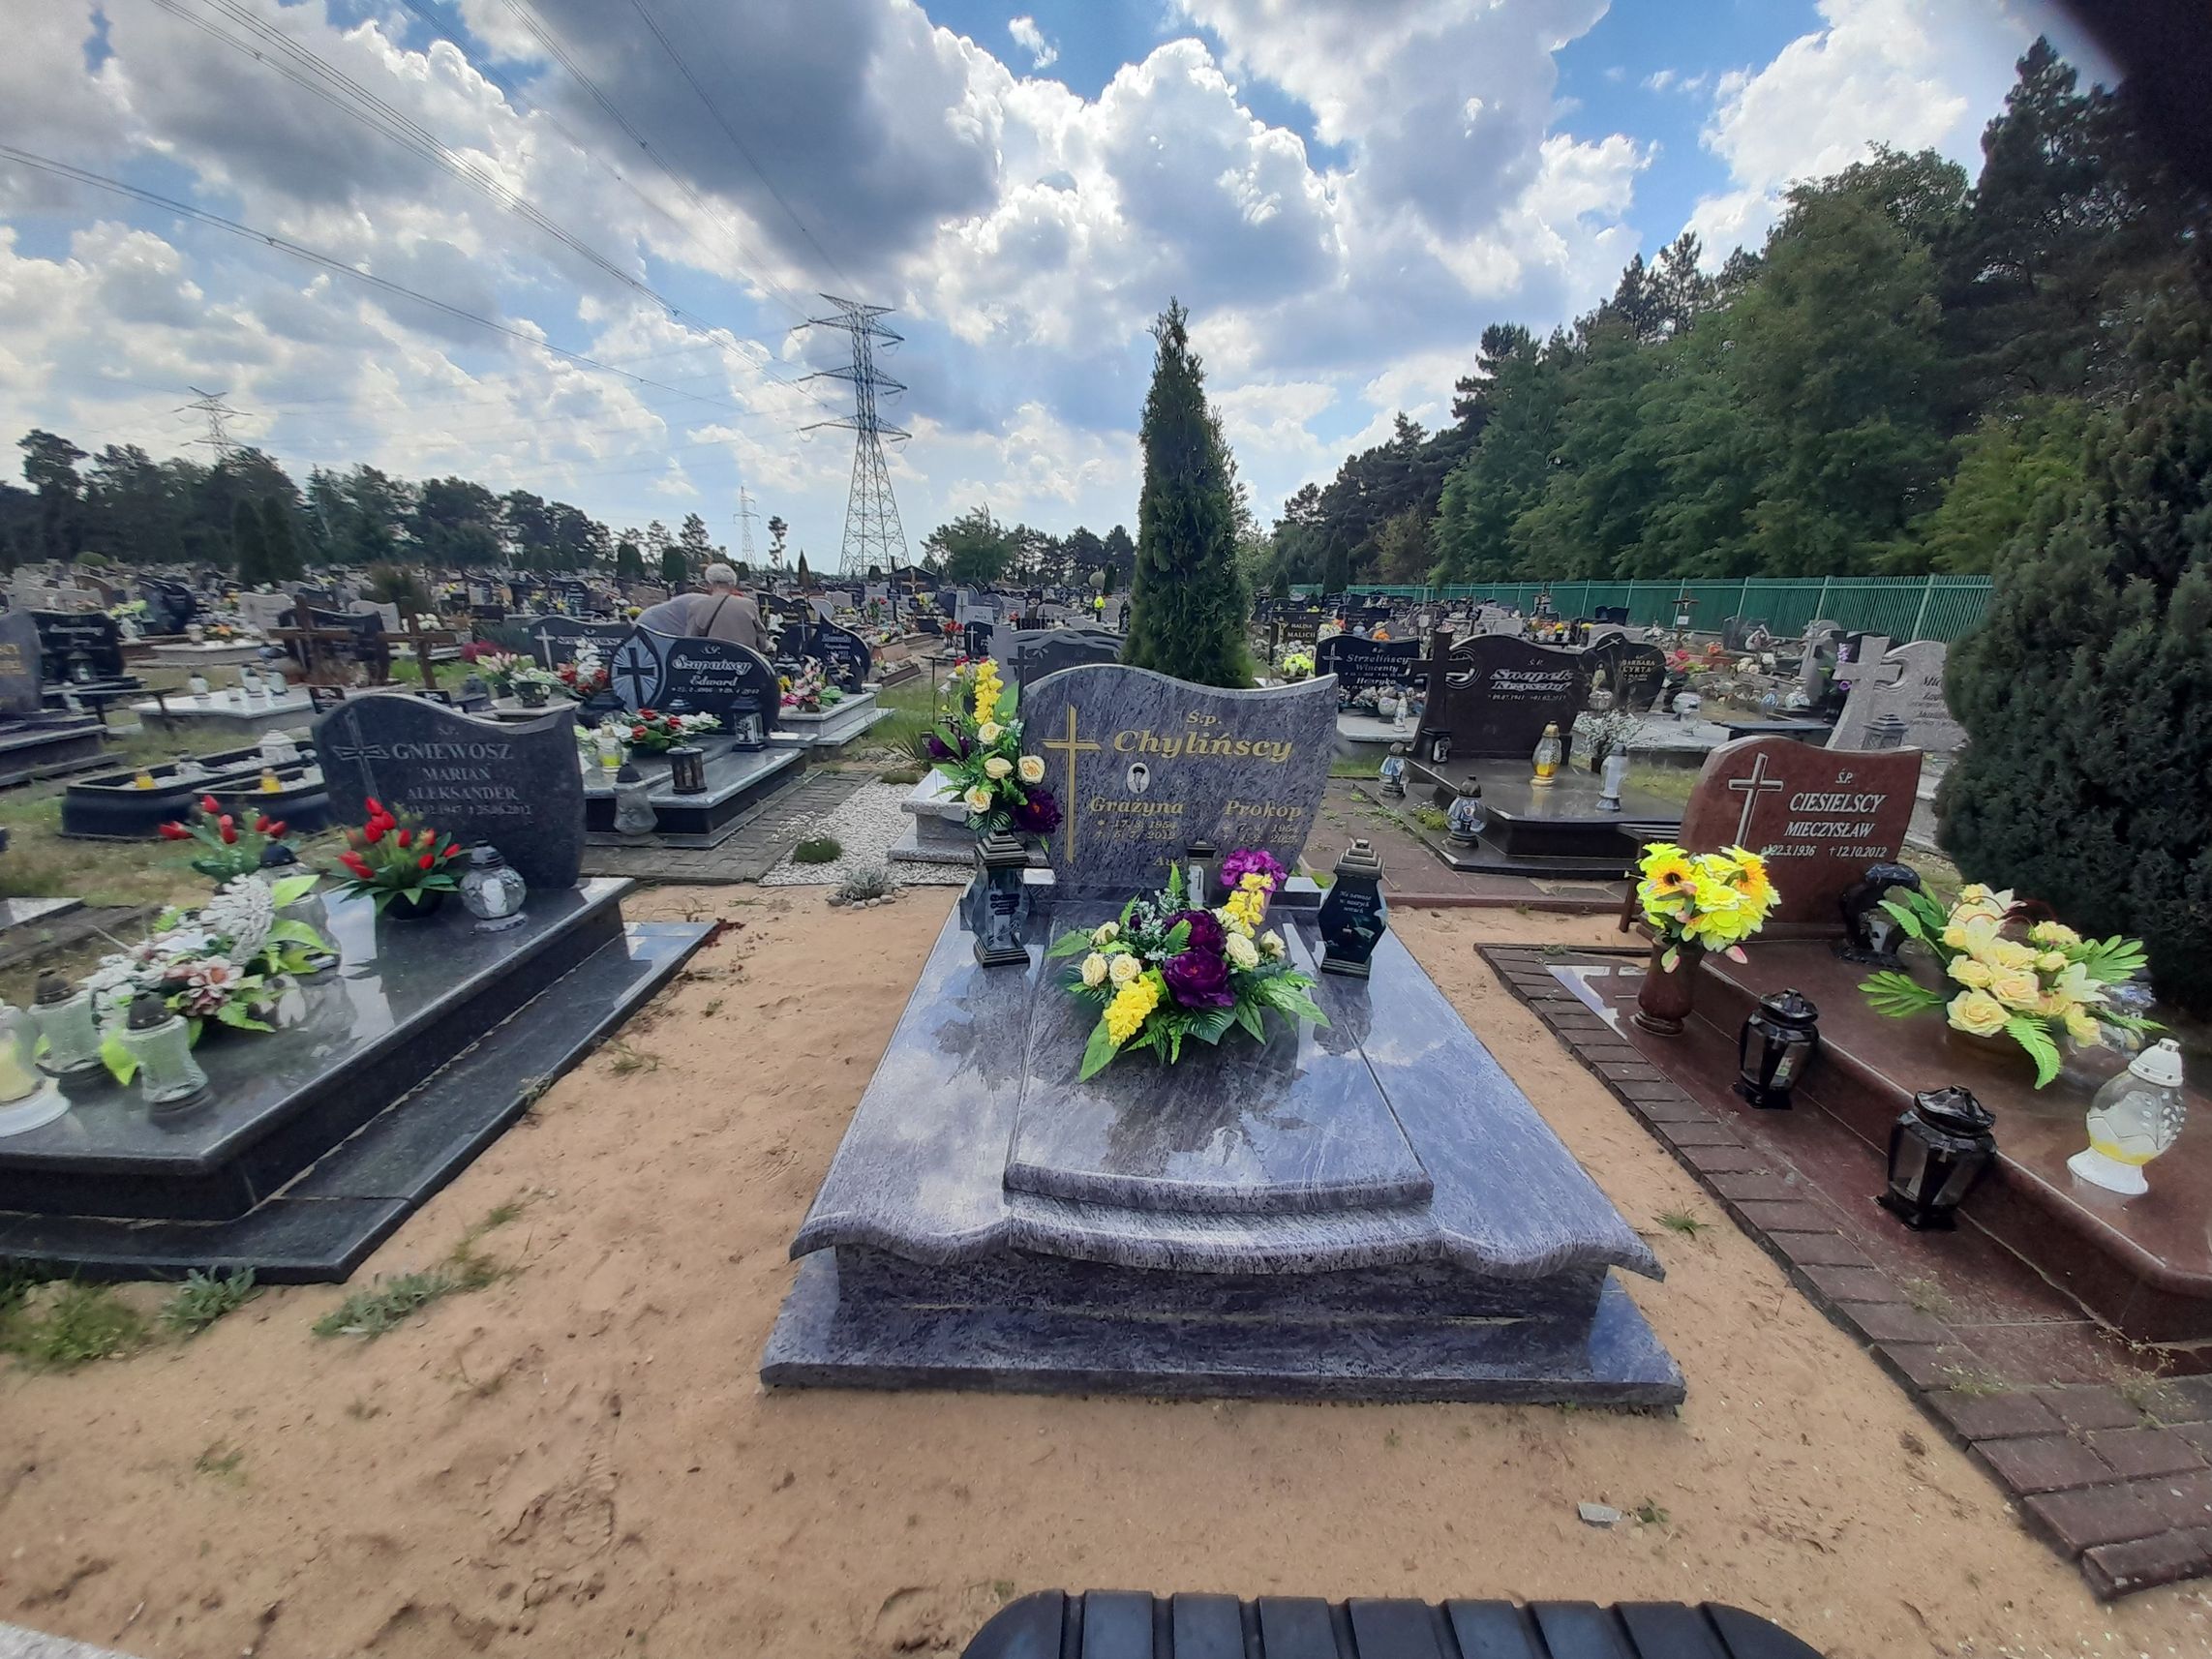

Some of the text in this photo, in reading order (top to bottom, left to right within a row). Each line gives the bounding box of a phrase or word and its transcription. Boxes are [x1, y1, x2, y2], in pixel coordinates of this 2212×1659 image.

[1346, 653, 1409, 665] Strzelińscy
[1355, 664, 1400, 673] Wincenty
[690, 675, 739, 686] Edward
[392, 743, 514, 760] GNIEWOSZ
[1113, 729, 1293, 763] Chylińscy
[421, 767, 492, 780] MARIAN
[406, 786, 520, 800] ALEKSANDER
[1090, 797, 1303, 822] Grażyna Prokop
[1789, 793, 1887, 813] CIESIELSCY
[1783, 821, 1876, 838] MIECZYSŁAW
